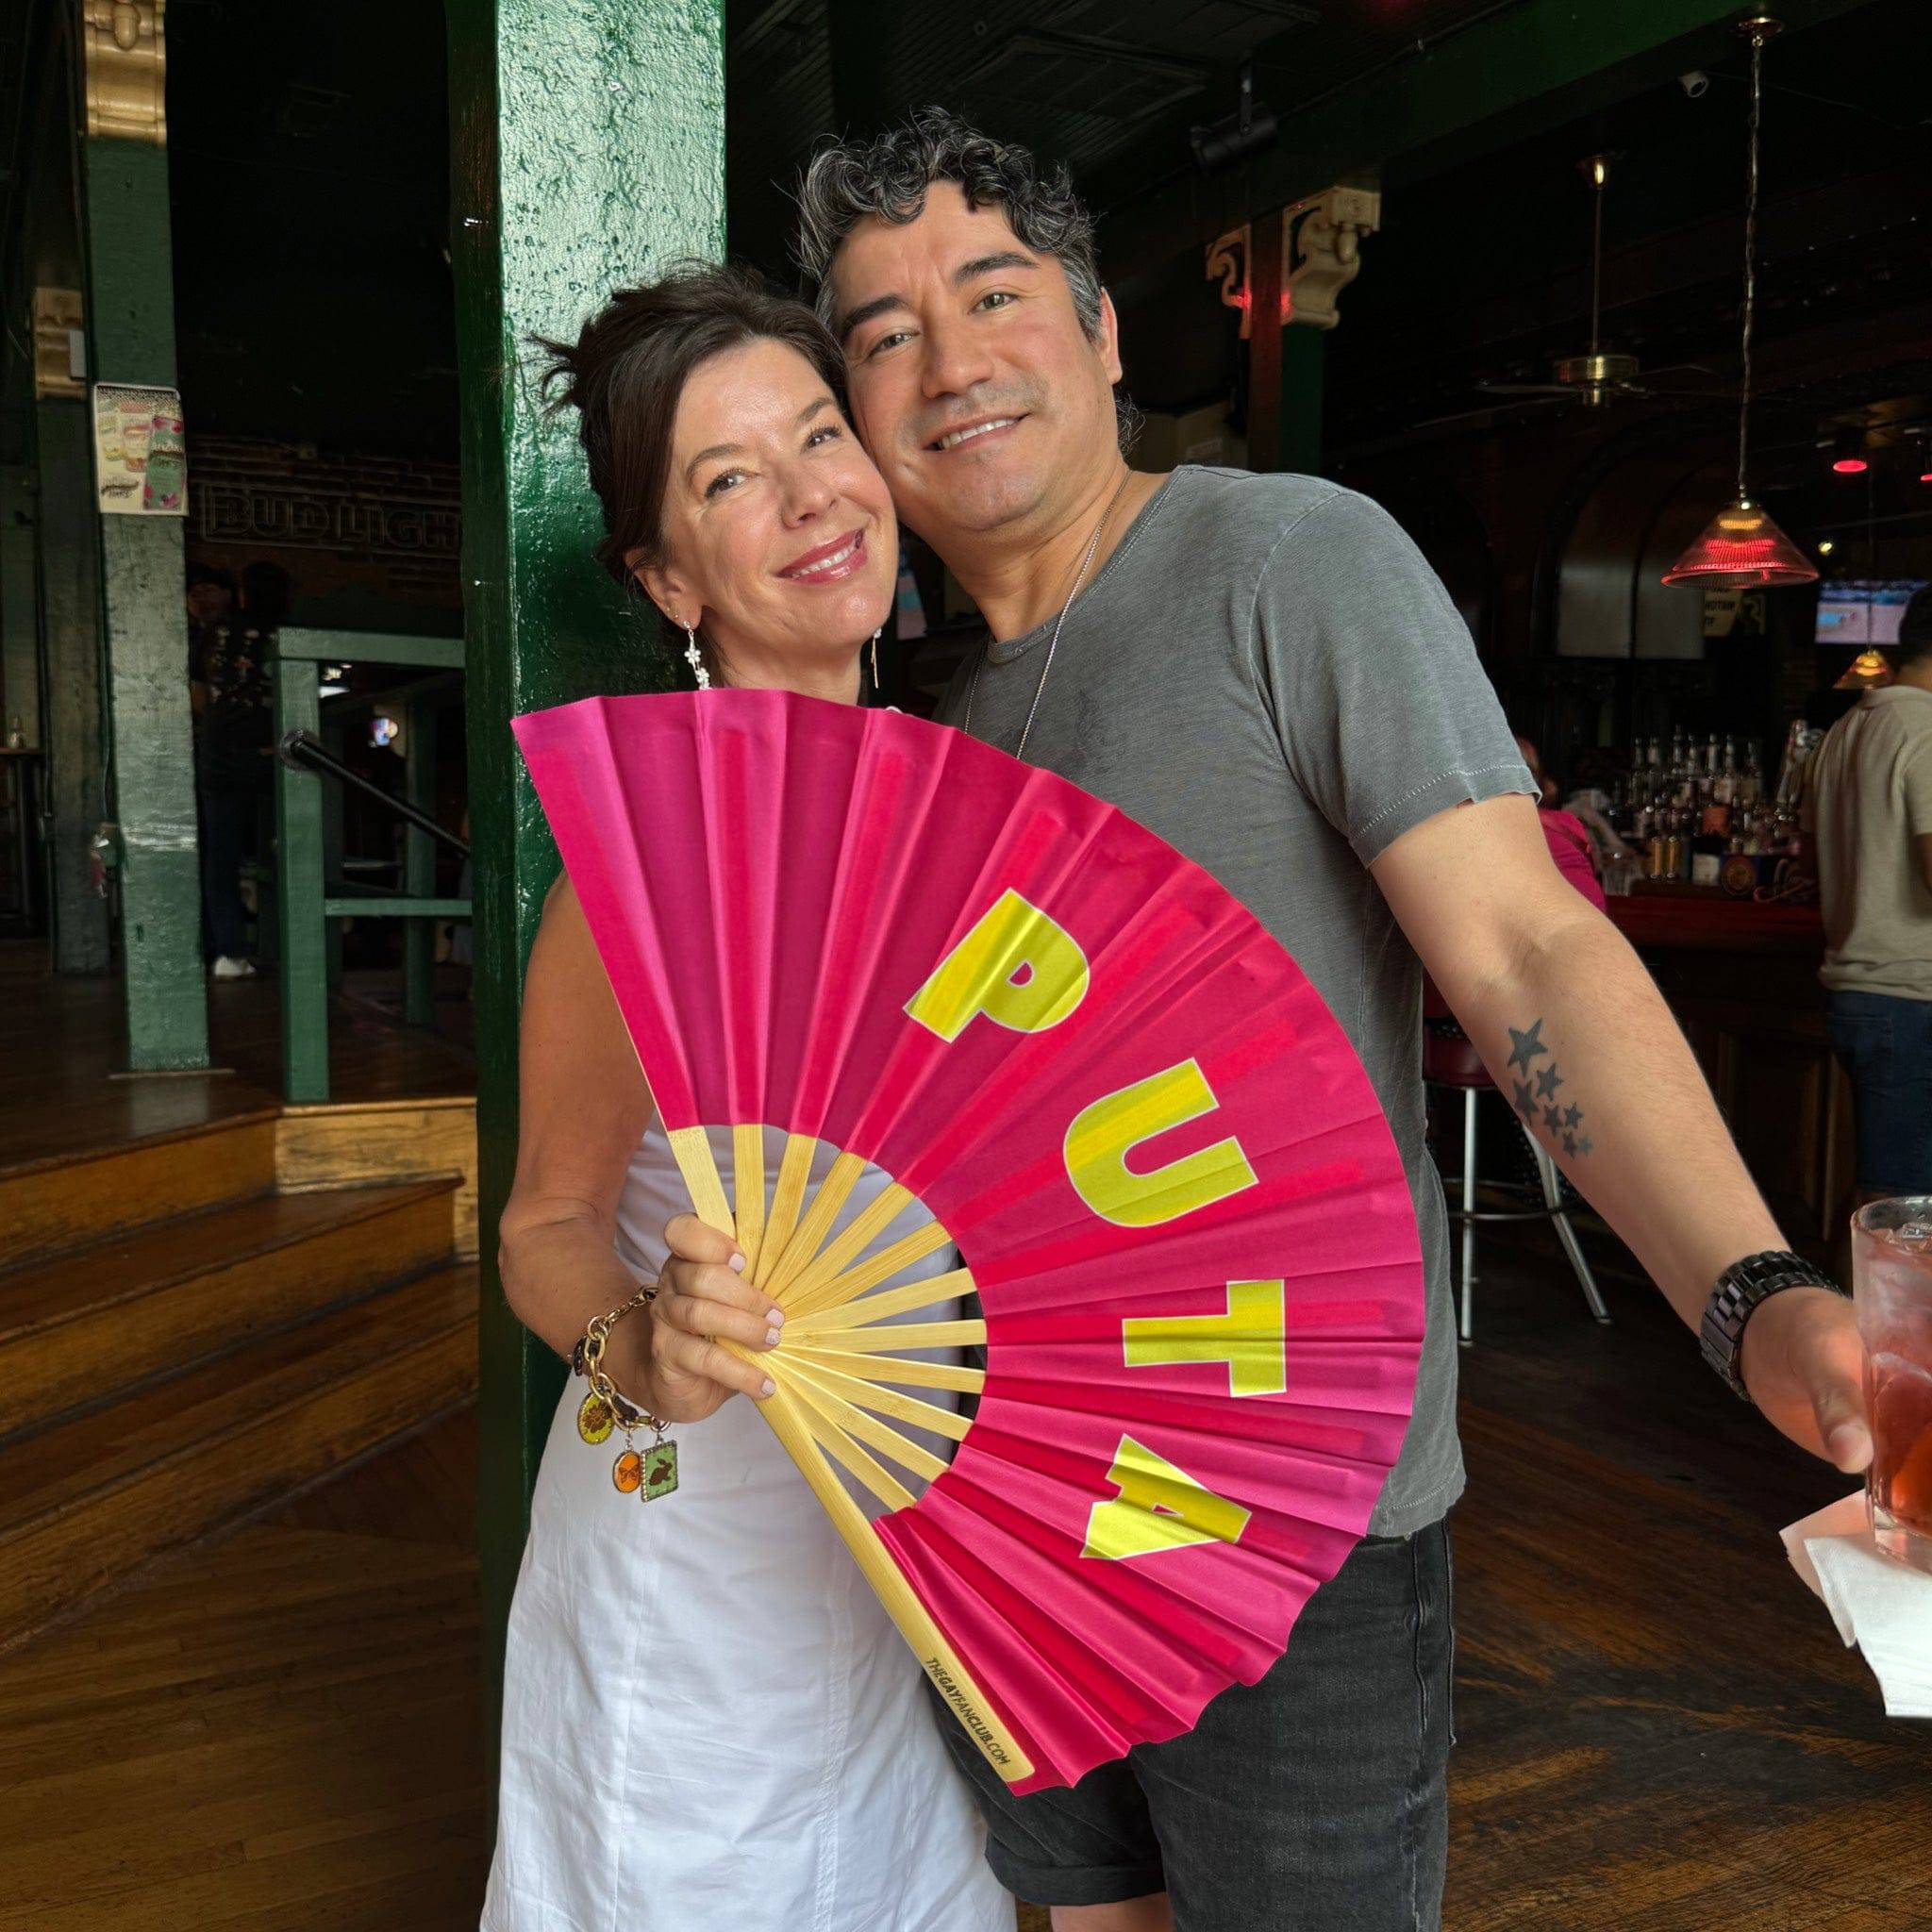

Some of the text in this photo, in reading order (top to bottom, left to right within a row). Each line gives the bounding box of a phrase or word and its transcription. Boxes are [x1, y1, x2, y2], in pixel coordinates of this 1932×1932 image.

[336, 500, 460, 551] LIGH
[903, 887, 1289, 1561] PUTA
[925, 1657, 1011, 1765] THEGAYFANCLUB.COM
